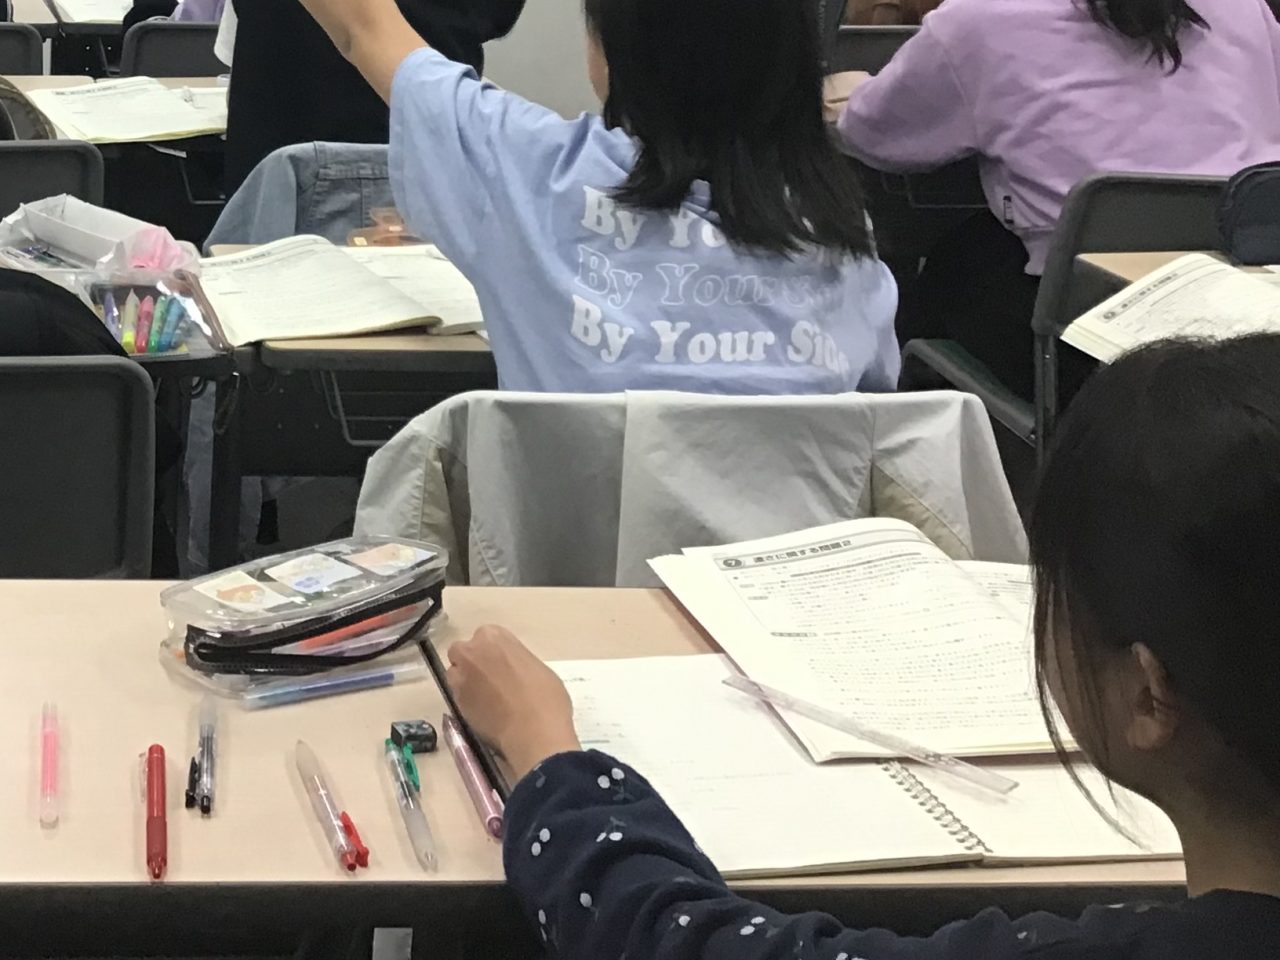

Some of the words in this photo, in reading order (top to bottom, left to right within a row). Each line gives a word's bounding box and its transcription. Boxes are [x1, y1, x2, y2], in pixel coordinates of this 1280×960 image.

[581, 185, 646, 251] By
[574, 244, 643, 309] By
[570, 293, 635, 363] By
[650, 320, 776, 363] Your
